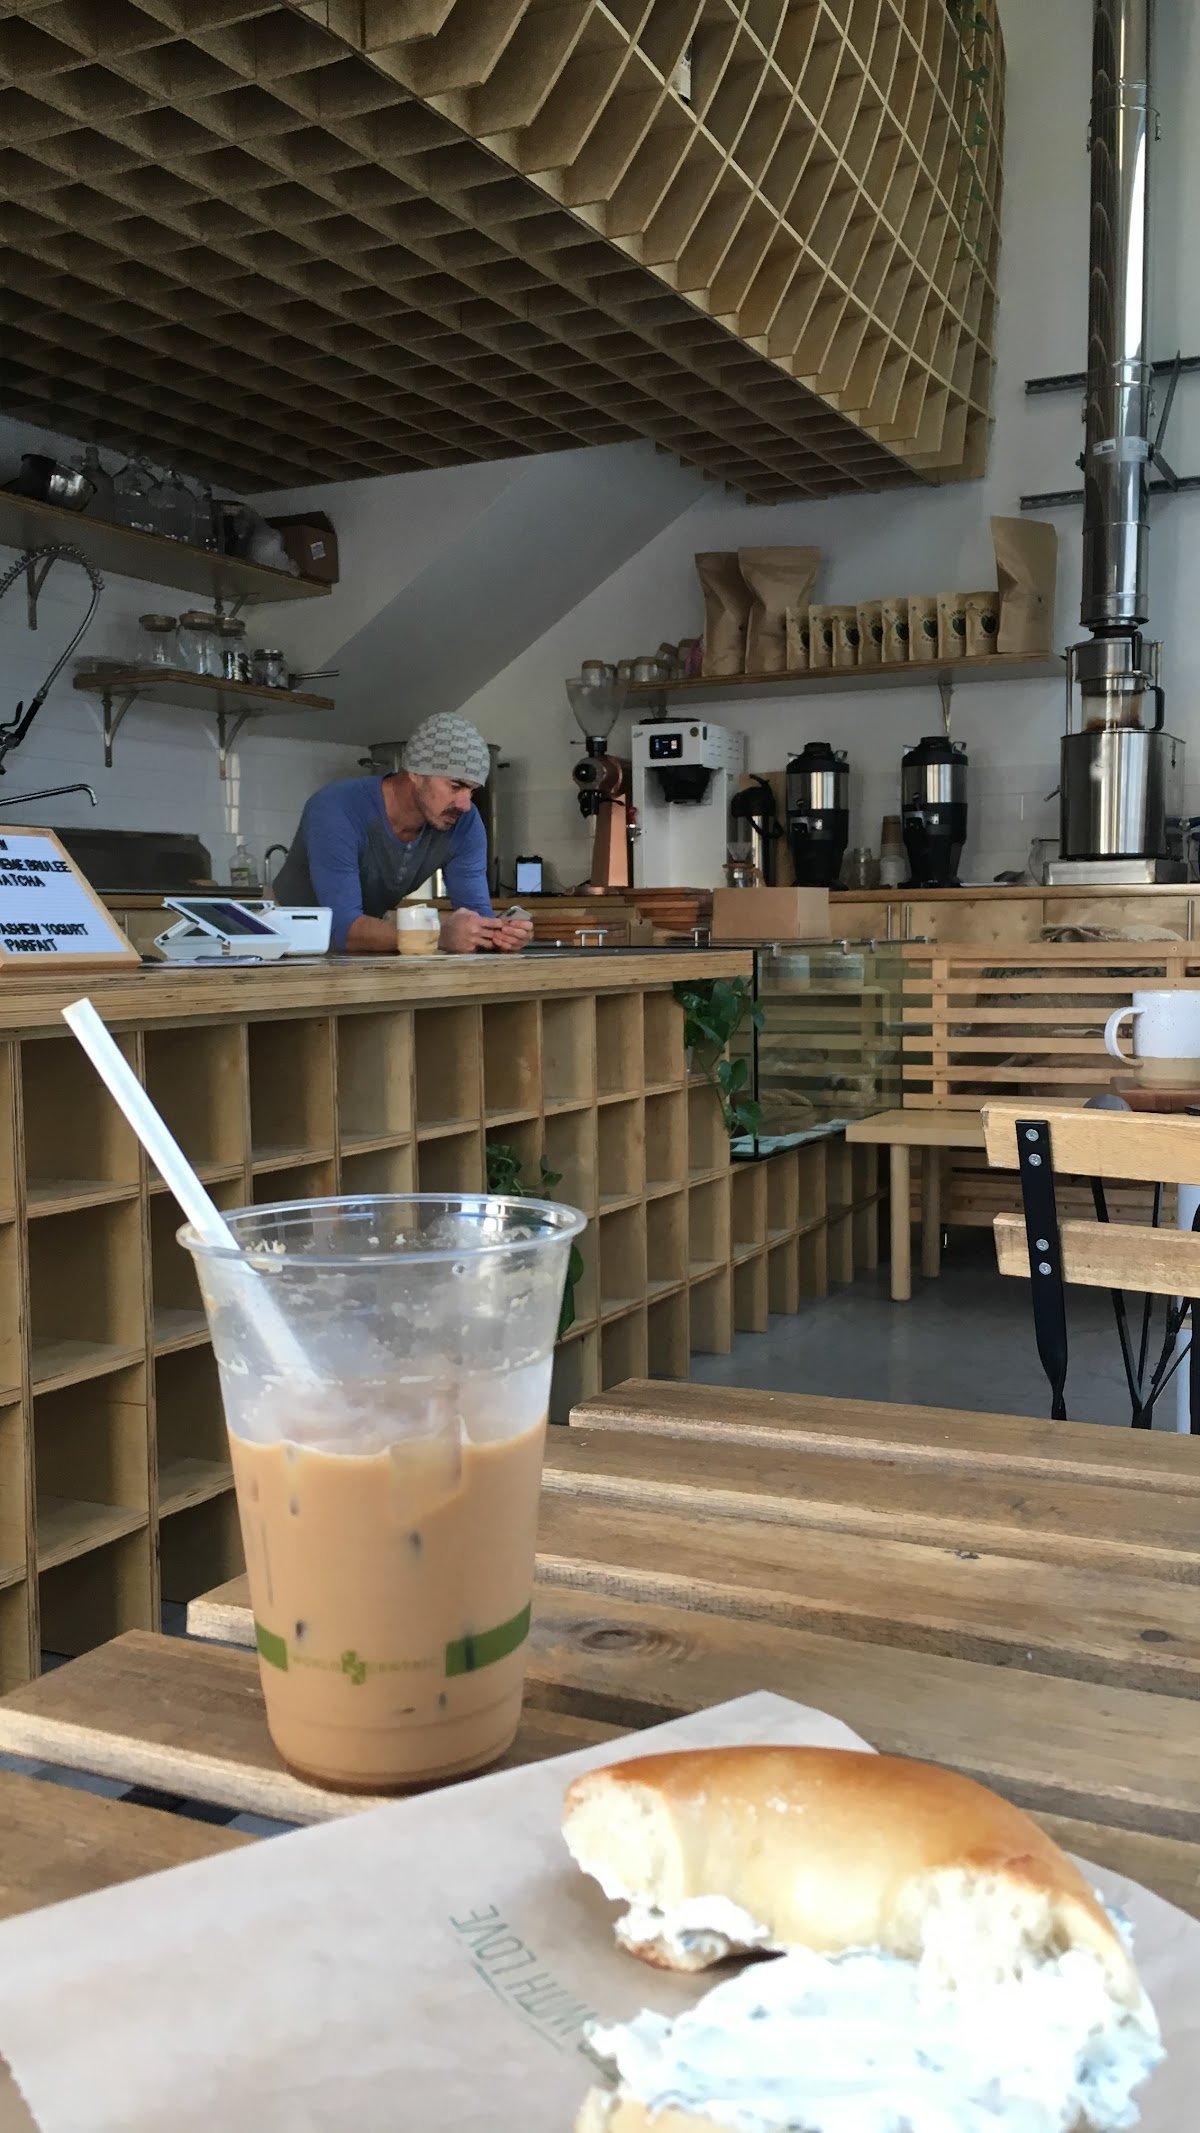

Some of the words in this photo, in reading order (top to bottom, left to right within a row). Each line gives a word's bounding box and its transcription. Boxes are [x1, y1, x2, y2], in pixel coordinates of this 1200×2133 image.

[24, 859, 72, 873] BRULEE
[41, 923, 89, 936] YOGURT
[4, 938, 58, 952] PARFAIT
[449, 1904, 538, 1976] LOVE
[503, 1972, 599, 2036] WITH
